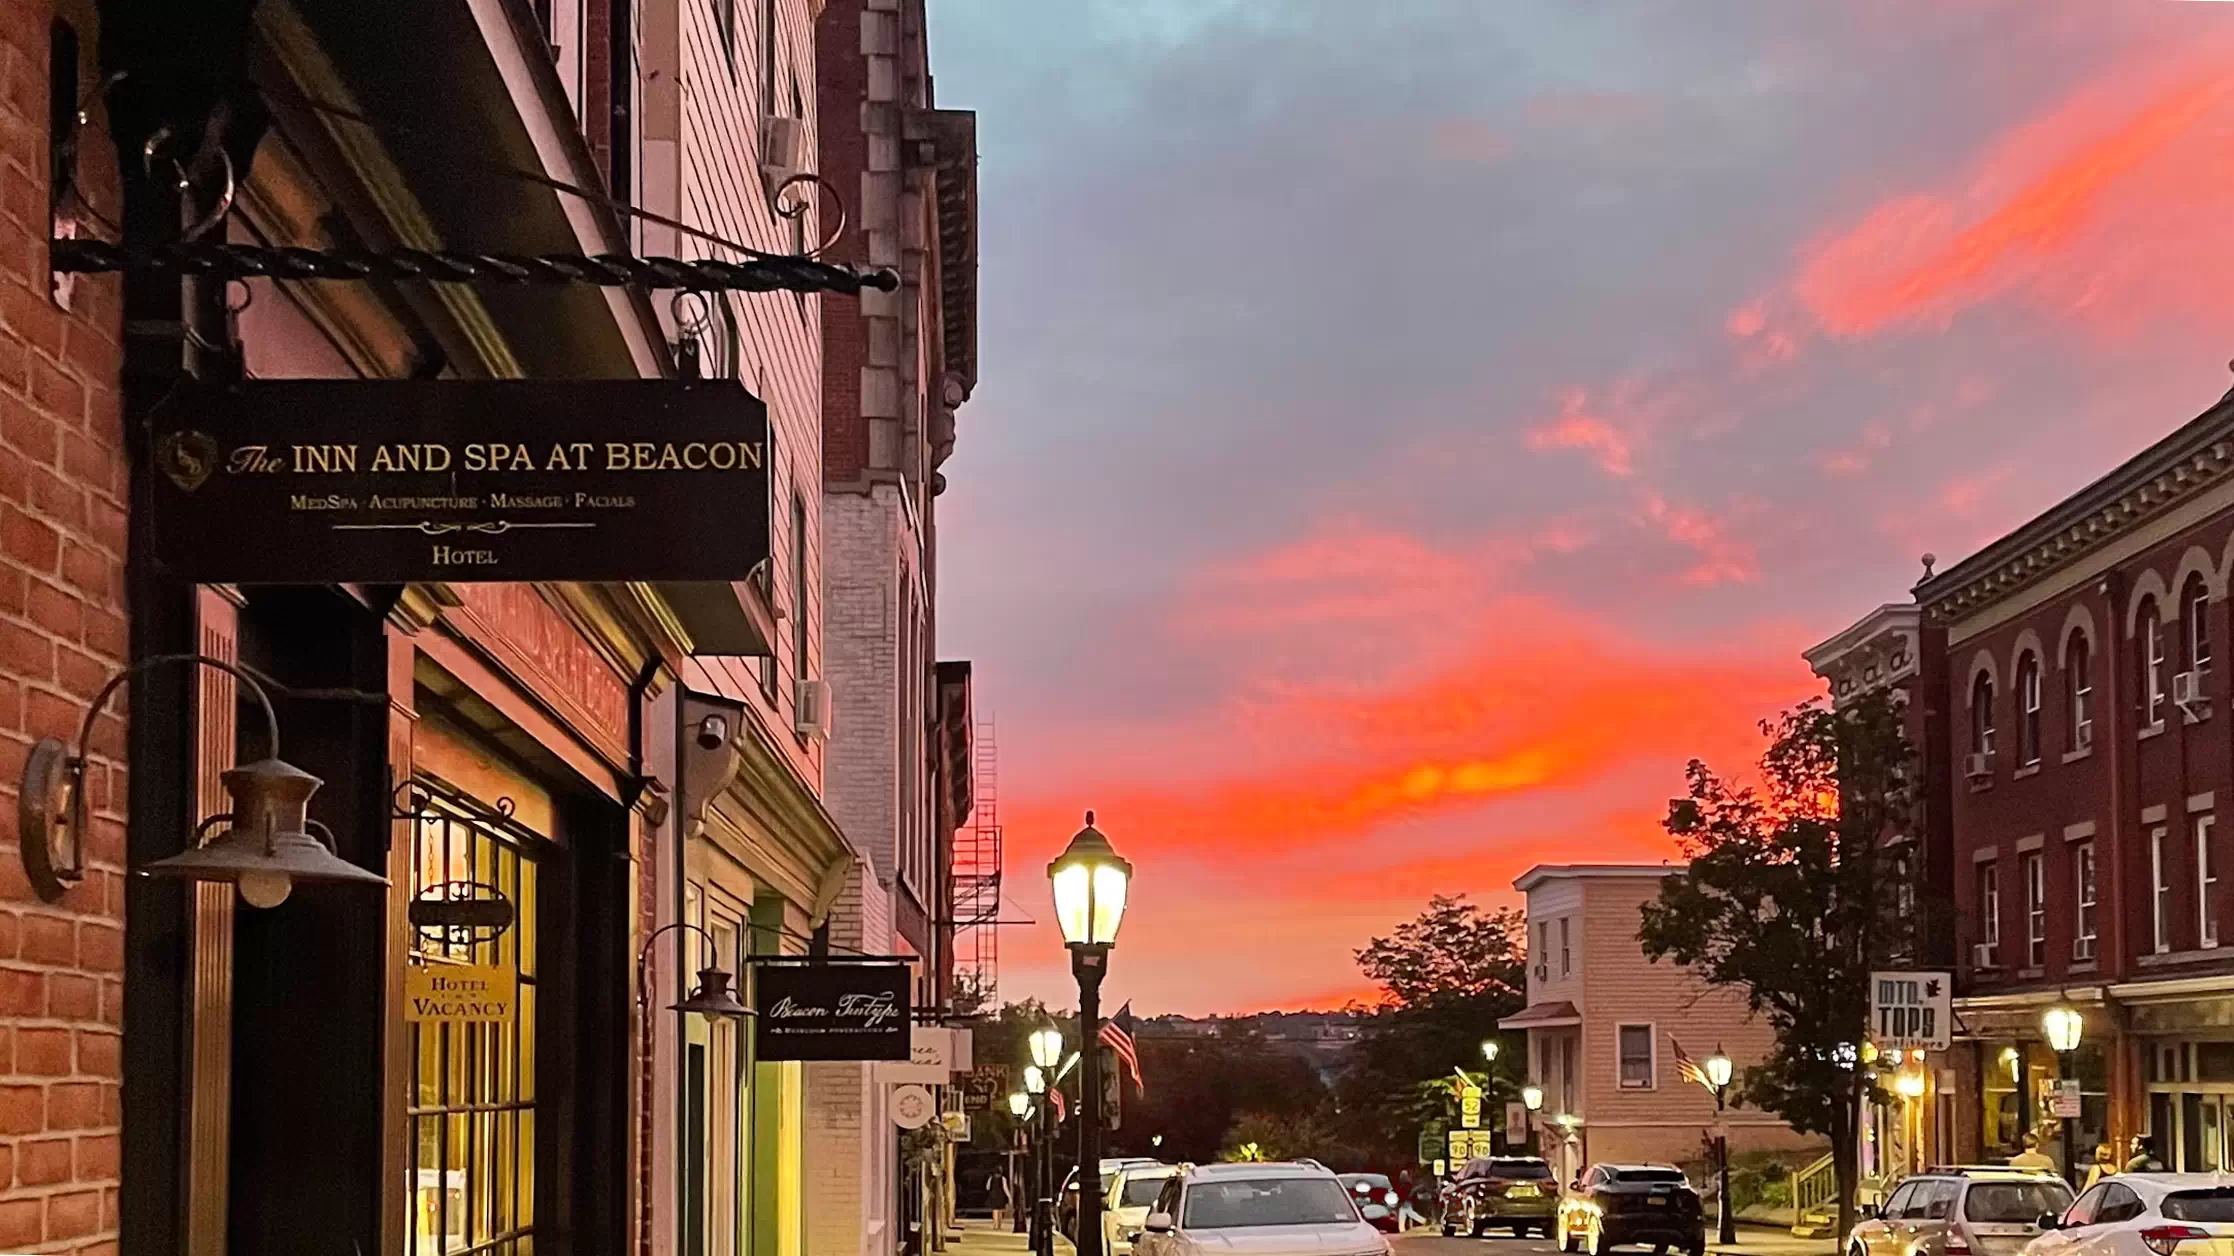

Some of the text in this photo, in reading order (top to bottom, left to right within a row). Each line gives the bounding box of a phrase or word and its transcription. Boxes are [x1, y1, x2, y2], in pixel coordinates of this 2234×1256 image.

[226, 442, 764, 475] The INN AND SPA AT BEACON
[769, 991, 900, 1027] Beacon Tintype
[964, 1066, 1006, 1078] ANK
